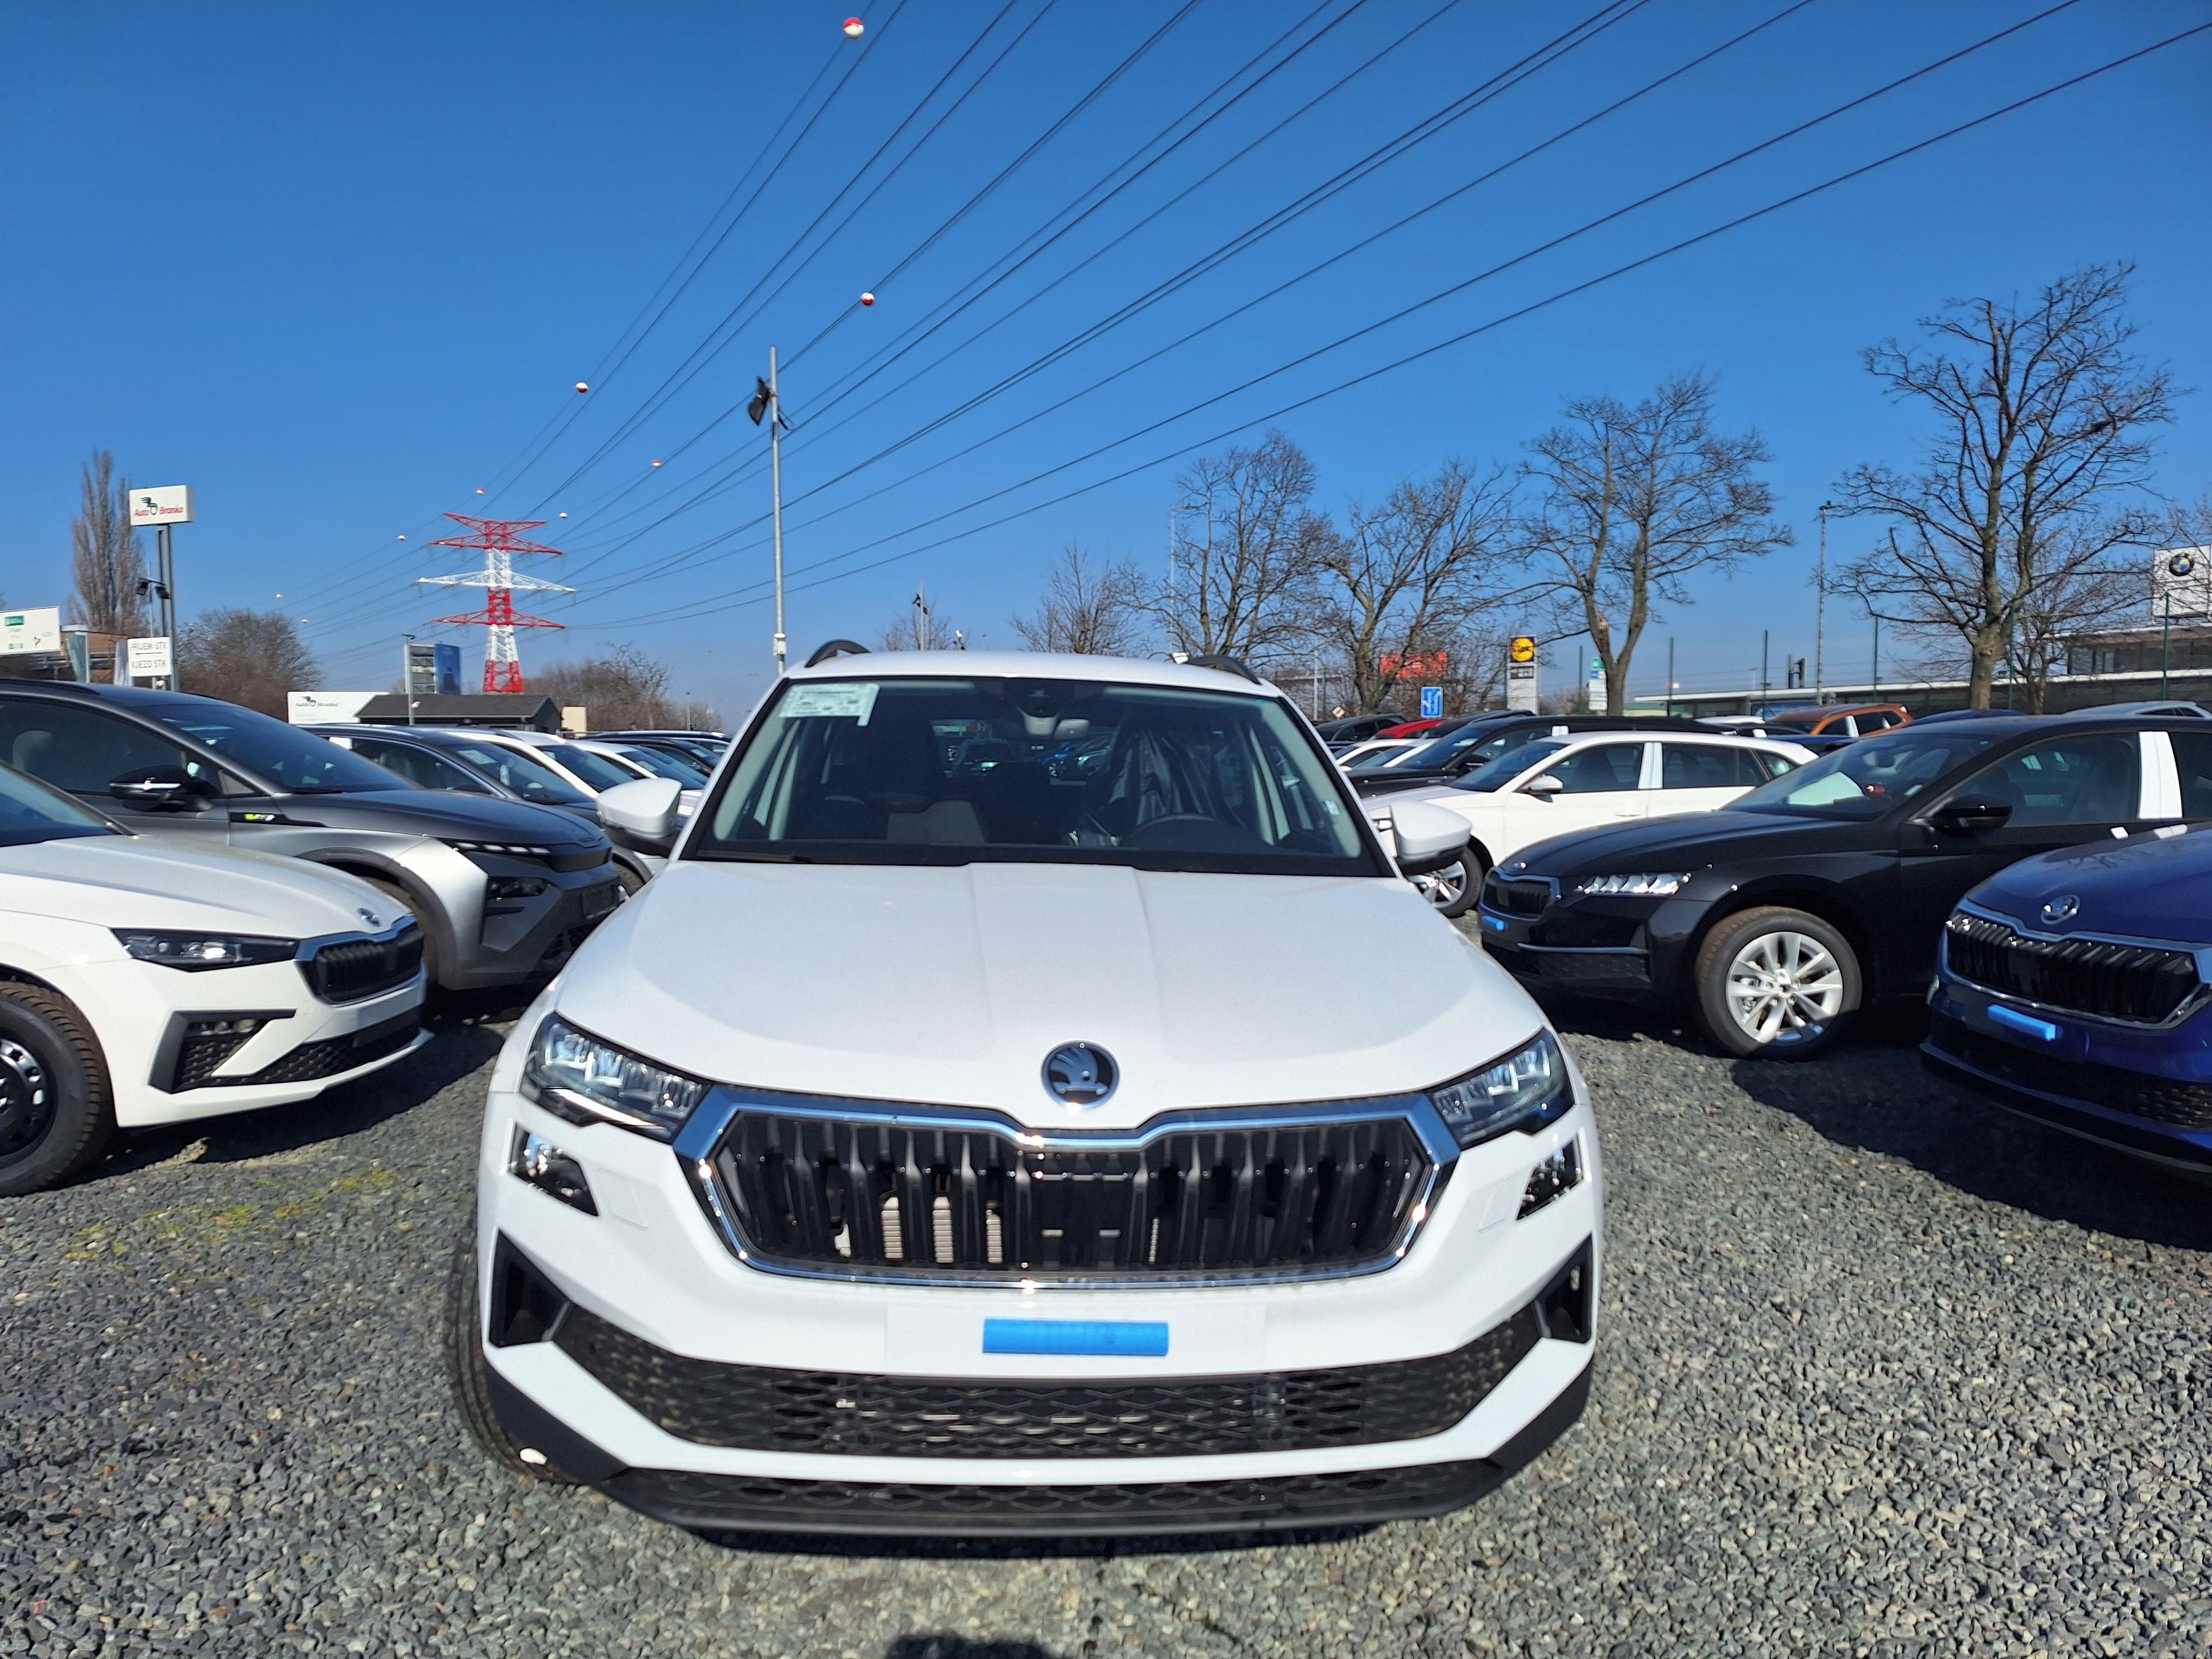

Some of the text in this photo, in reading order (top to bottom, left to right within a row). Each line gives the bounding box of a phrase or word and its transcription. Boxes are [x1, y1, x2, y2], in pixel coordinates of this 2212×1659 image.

[159, 505, 183, 514] Branka
[131, 659, 166, 668] VJEZD STK
